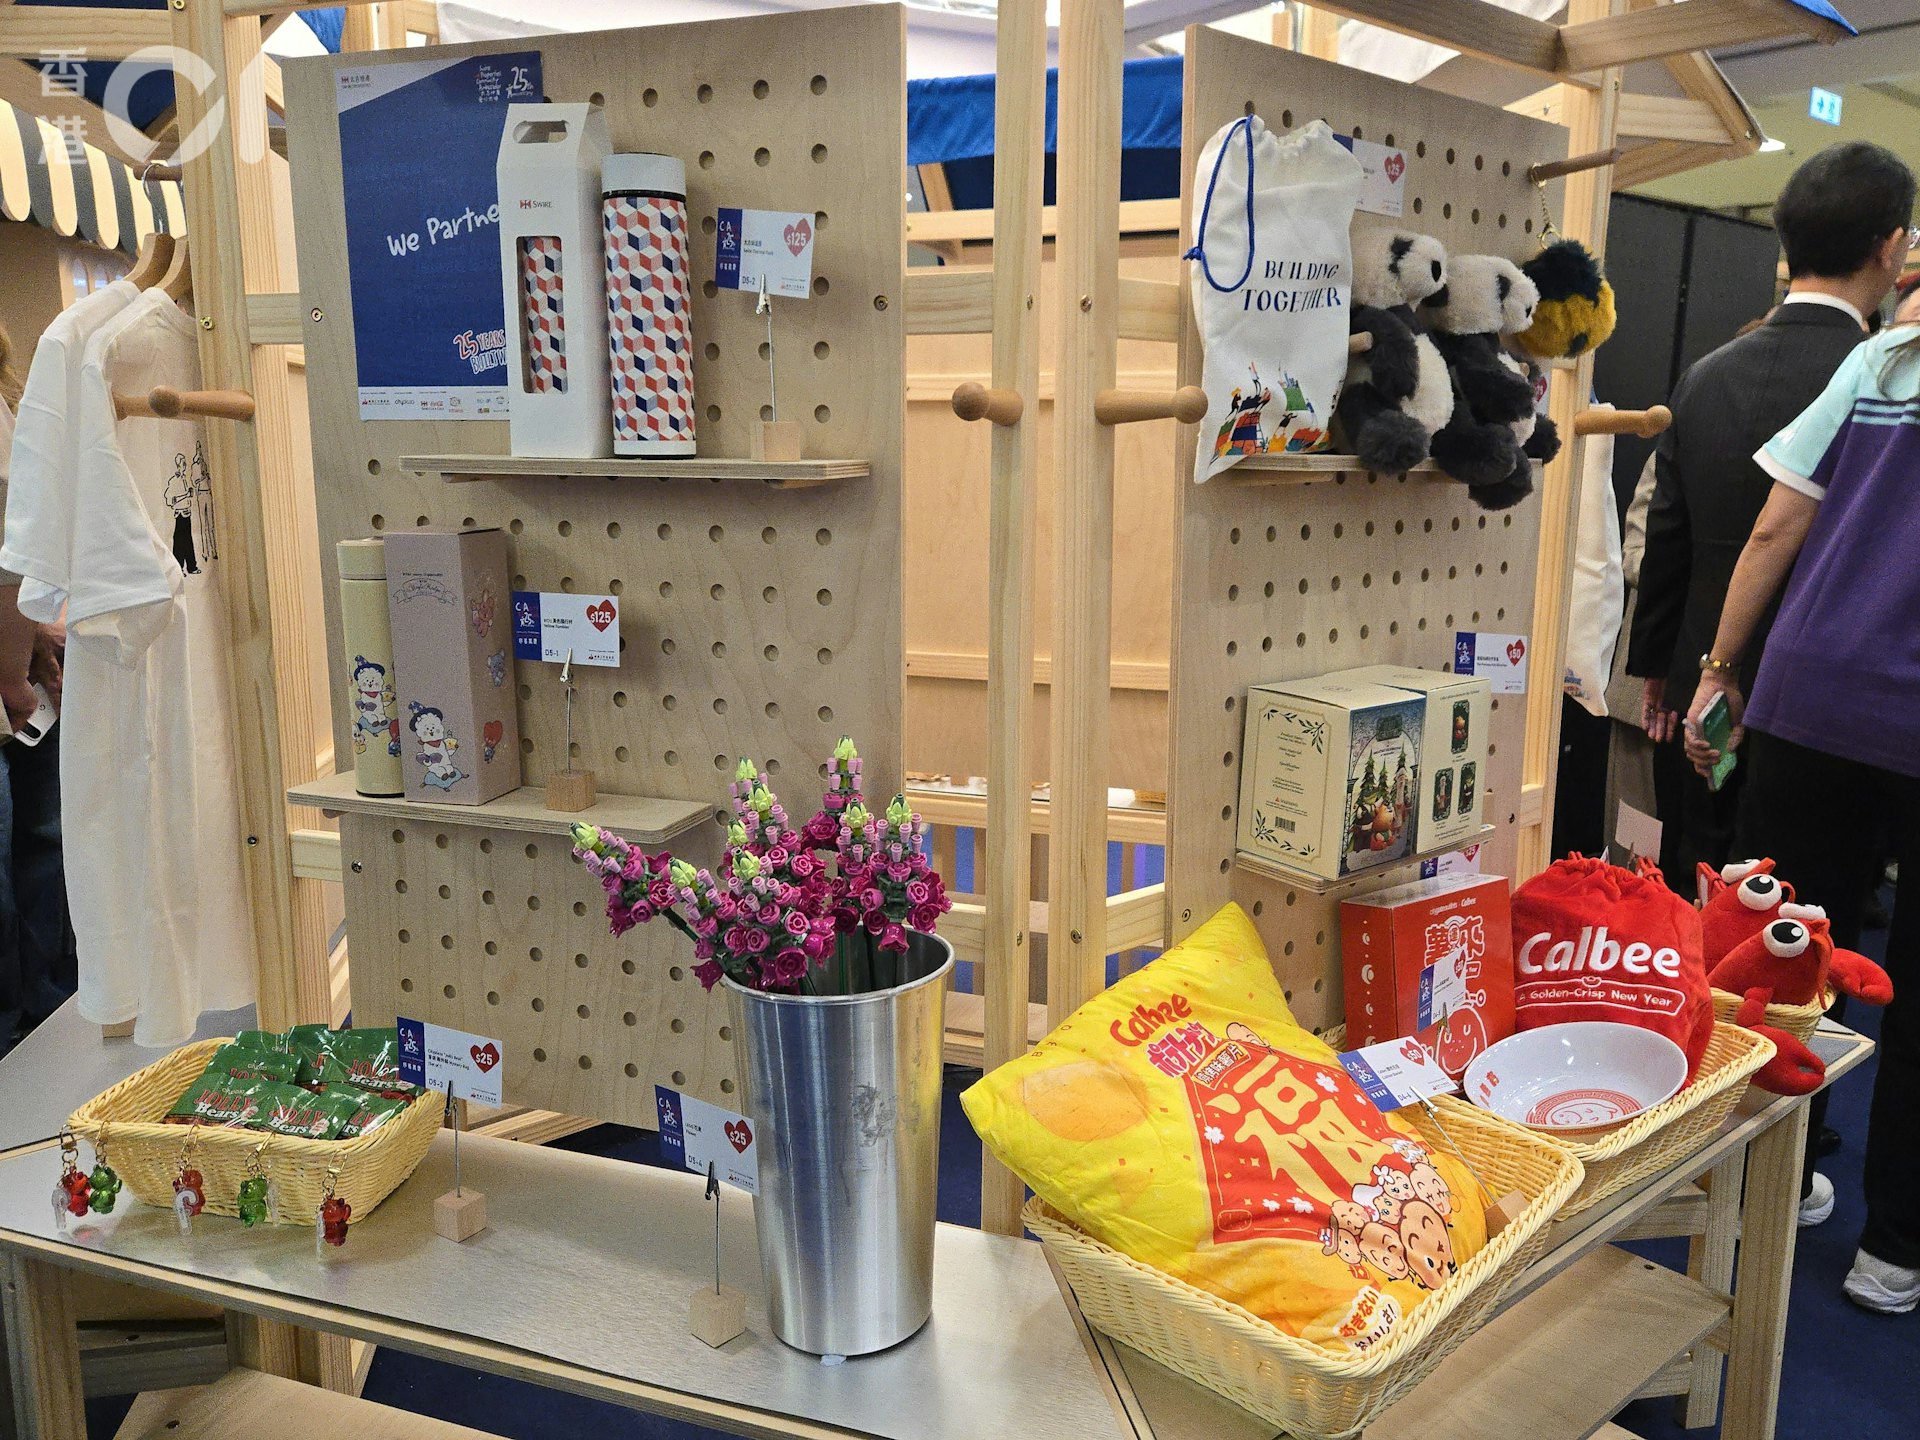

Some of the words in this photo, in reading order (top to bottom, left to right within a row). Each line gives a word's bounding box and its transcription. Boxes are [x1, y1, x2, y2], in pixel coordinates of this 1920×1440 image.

[387, 230, 421, 257] We
[786, 232, 806, 246] $125
[1264, 260, 1341, 281] BUILDING
[1240, 287, 1342, 314] TOGETHER
[453, 329, 479, 360] 25
[476, 329, 506, 351] YEARS
[590, 610, 612, 625] $125
[1519, 926, 1680, 977] Calbee
[1530, 987, 1607, 999] Golden-Crisp
[1611, 989, 1638, 1002] New
[1643, 993, 1673, 1007] Year
[475, 1052, 493, 1066] $25
[428, 1078, 444, 1088] D5-3
[194, 1089, 254, 1111] JOLLY
[195, 1101, 239, 1119] Bears
[268, 1116, 309, 1134] Bears
[1205, 1054, 1396, 1204] 福
[729, 1130, 747, 1146] $25
